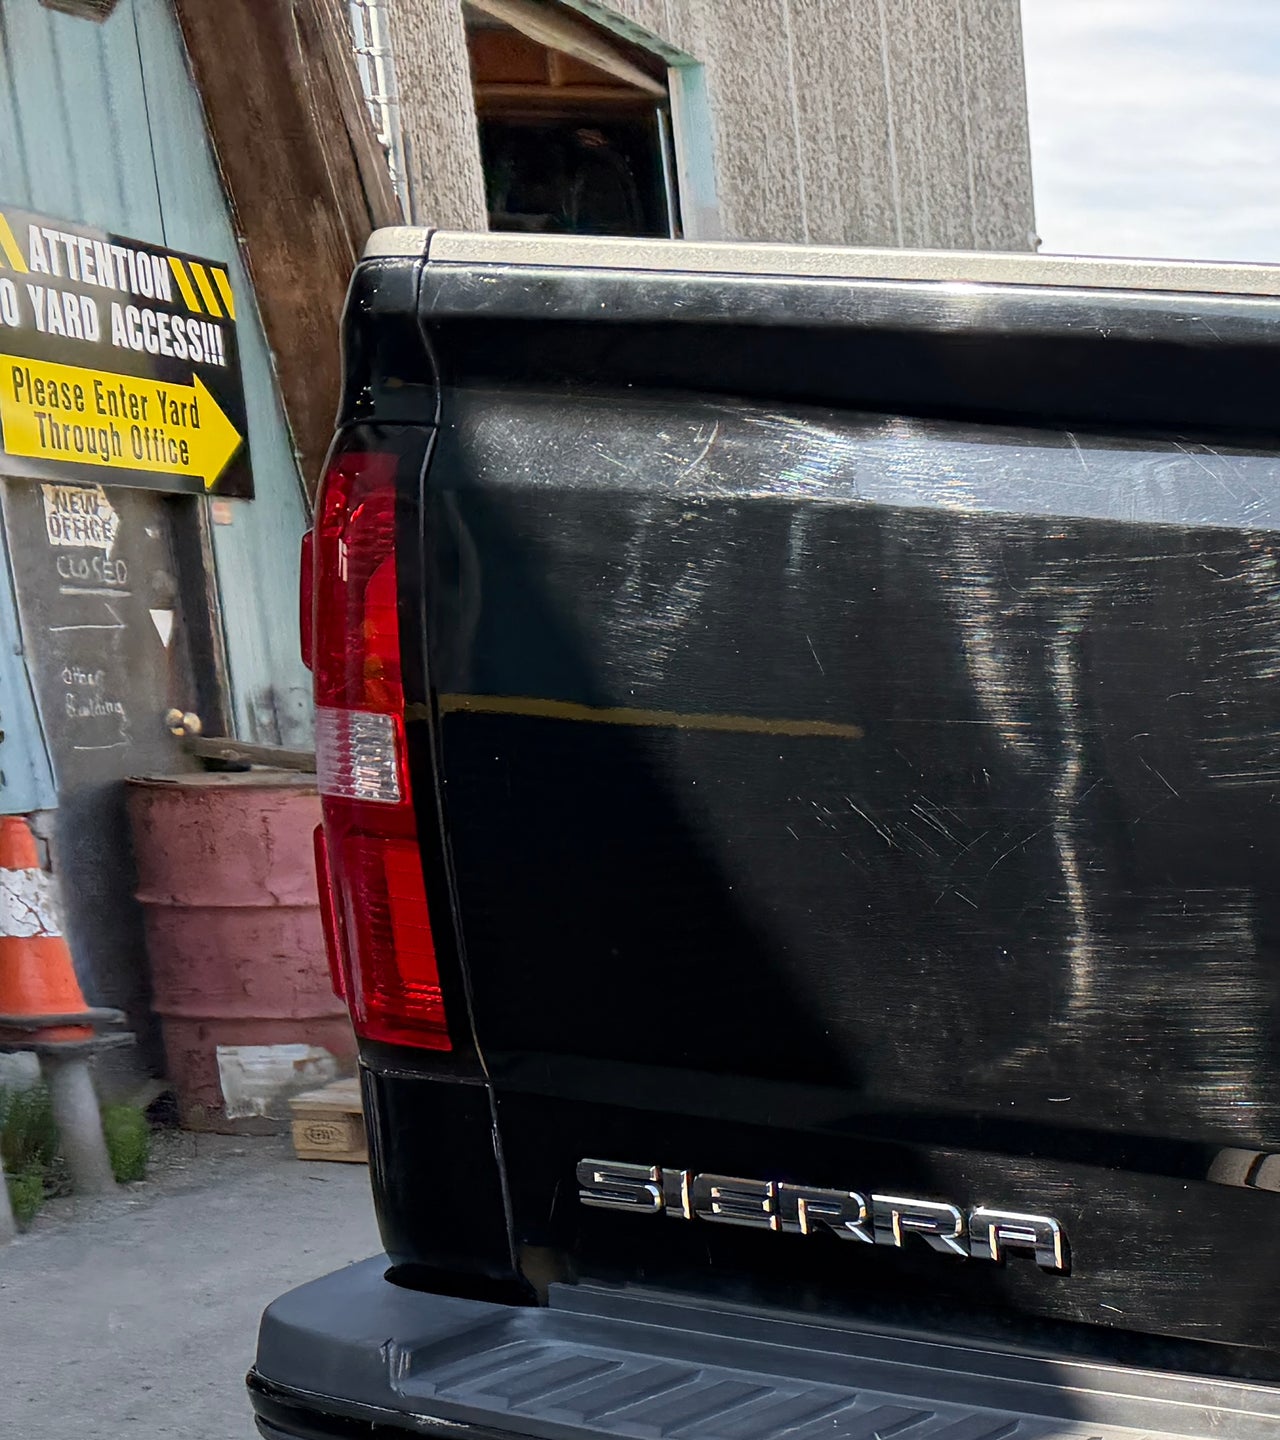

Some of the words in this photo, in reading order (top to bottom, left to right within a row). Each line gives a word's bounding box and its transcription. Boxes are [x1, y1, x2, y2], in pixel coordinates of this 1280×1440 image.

[29, 224, 173, 303] ATTENTION
[0, 277, 20, 328] O
[26, 283, 100, 342] YARD
[111, 302, 226, 367] ACCESS!!!
[12, 366, 85, 412] Please
[93, 379, 148, 421] Enter
[157, 389, 201, 429] Yard
[34, 411, 123, 462] Through
[130, 424, 190, 466] Office
[49, 514, 115, 542] OFFICE
[50, 491, 100, 514] NEW
[56, 554, 128, 584] CLOSED
[576, 1157, 1072, 1272] SIERRA
